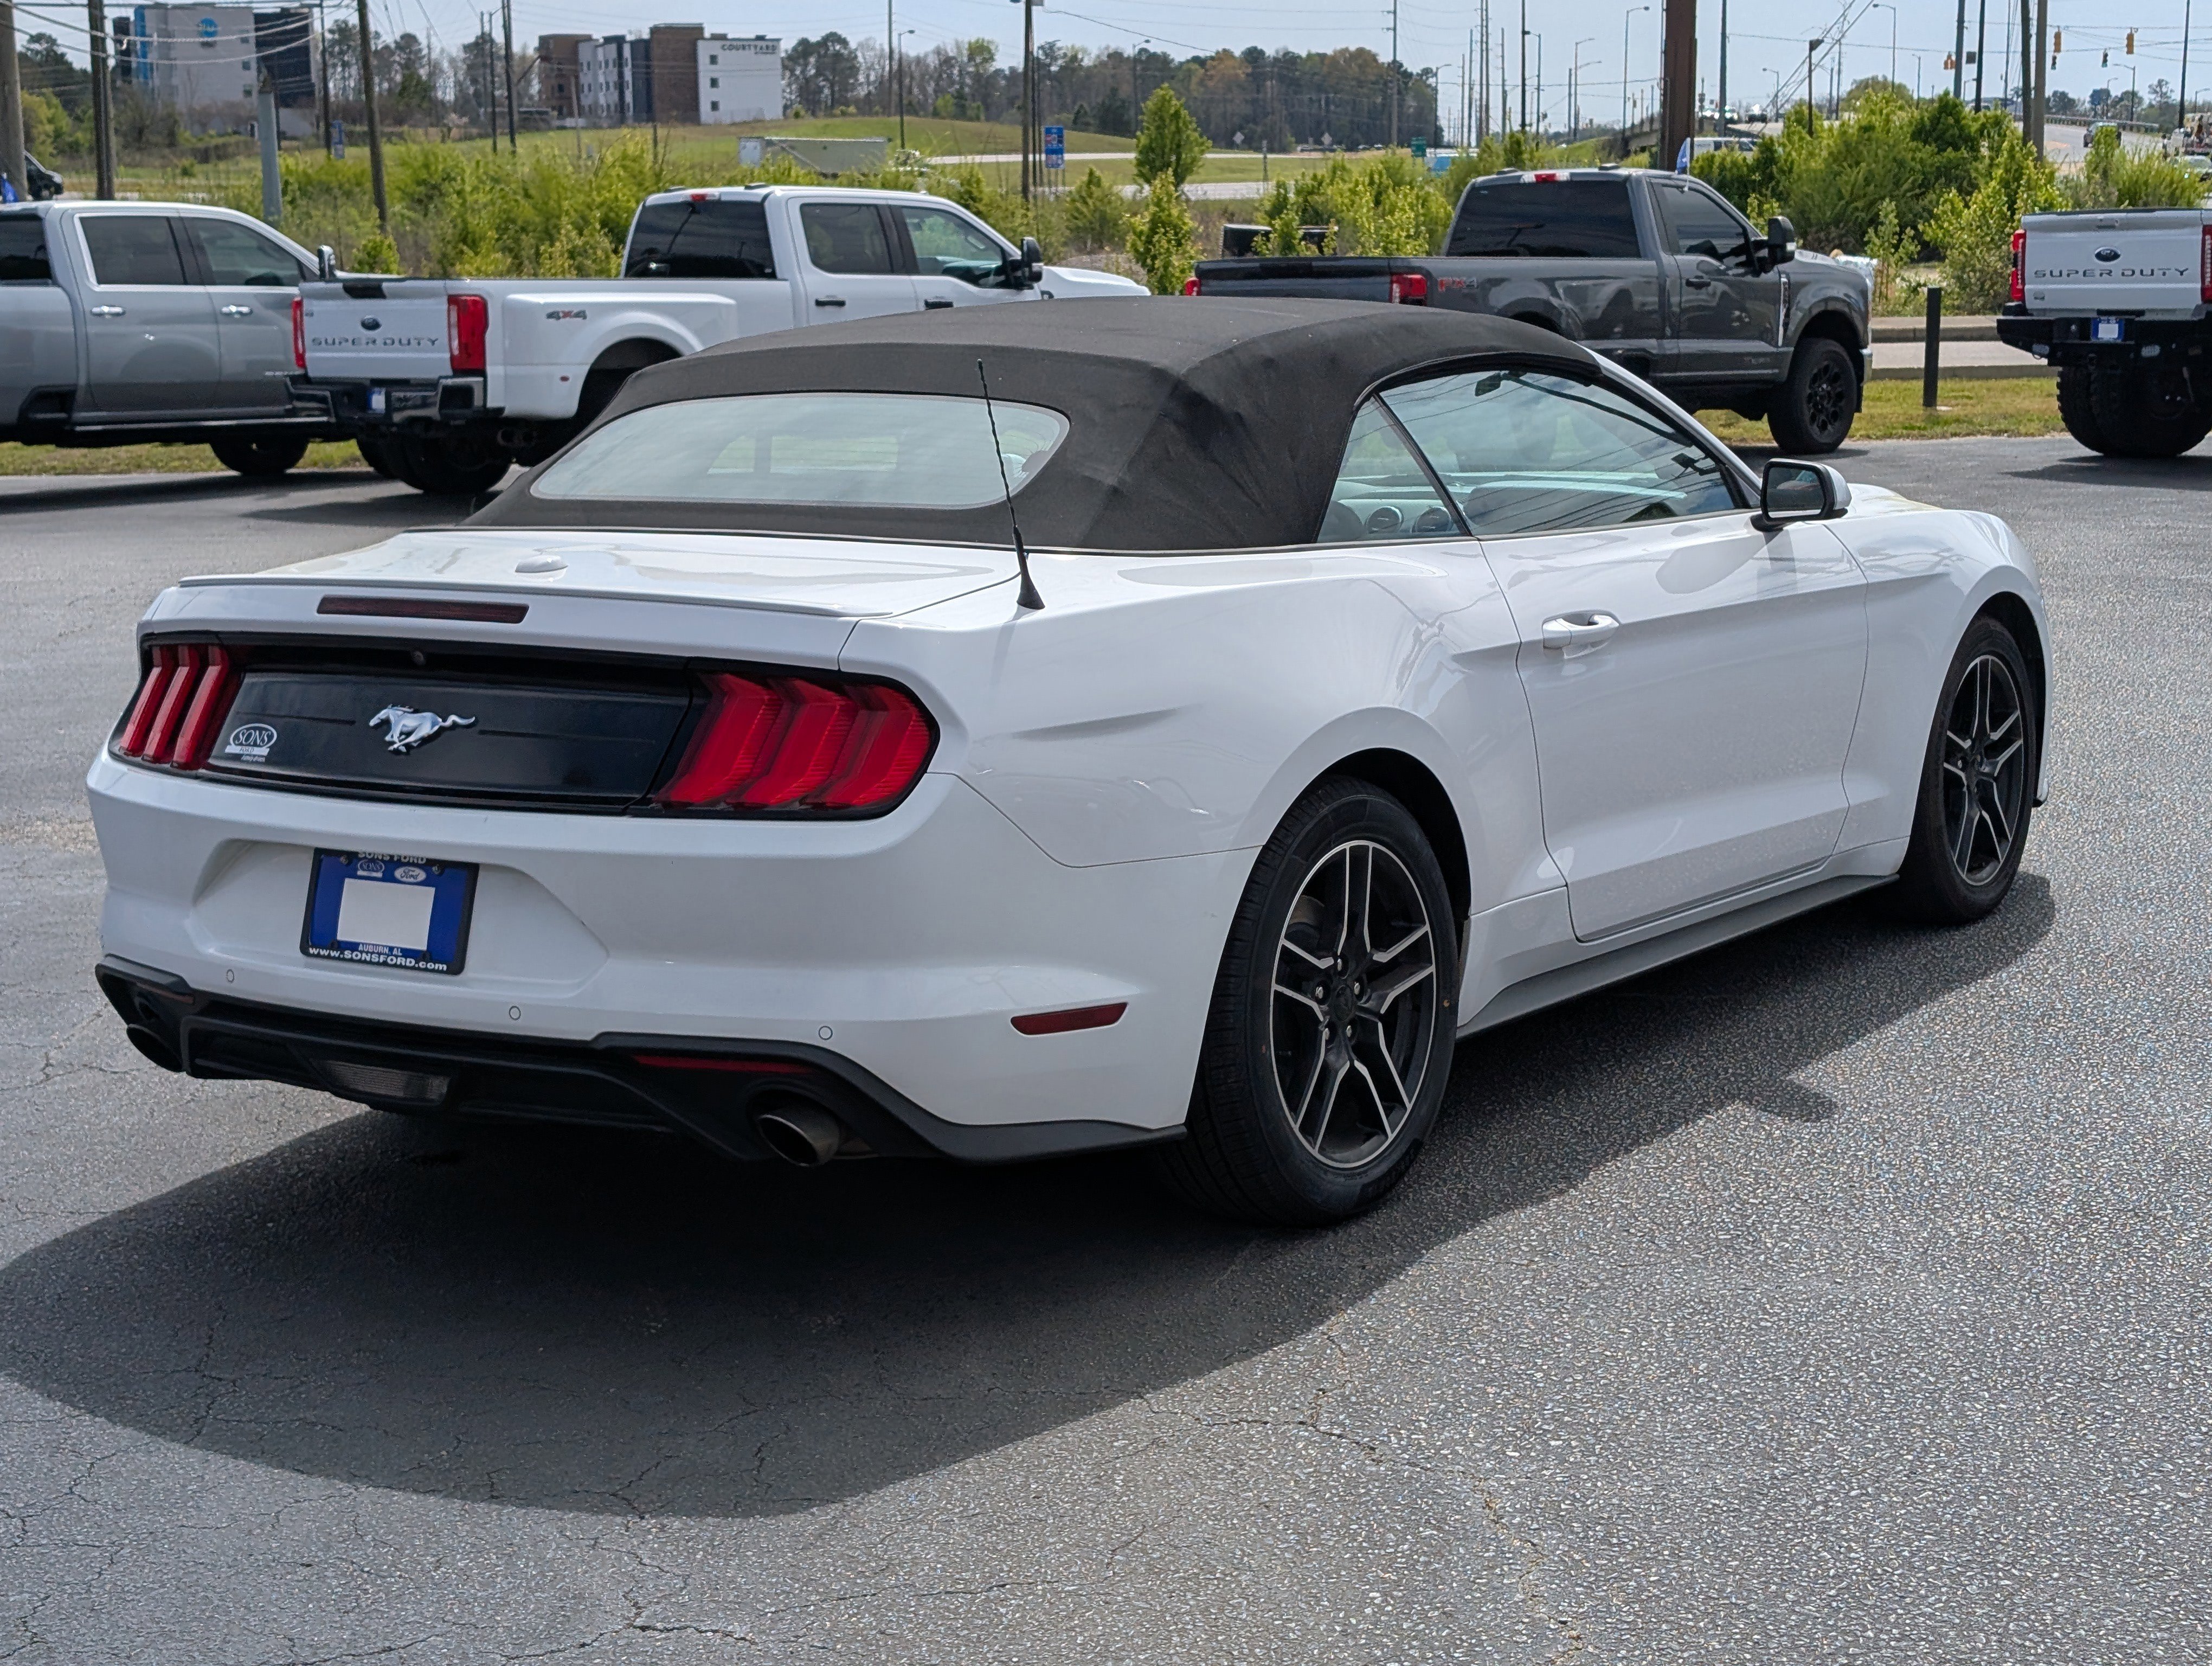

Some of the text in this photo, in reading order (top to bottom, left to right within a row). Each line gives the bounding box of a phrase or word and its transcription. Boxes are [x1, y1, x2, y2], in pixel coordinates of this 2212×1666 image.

[2034, 267, 2189, 278] SUPER DUTY
[311, 336, 439, 346] SUPER DUTY
[235, 729, 271, 746] SONS
[400, 868, 421, 880] Ford
[309, 947, 447, 971] www.SONSFORD.com
